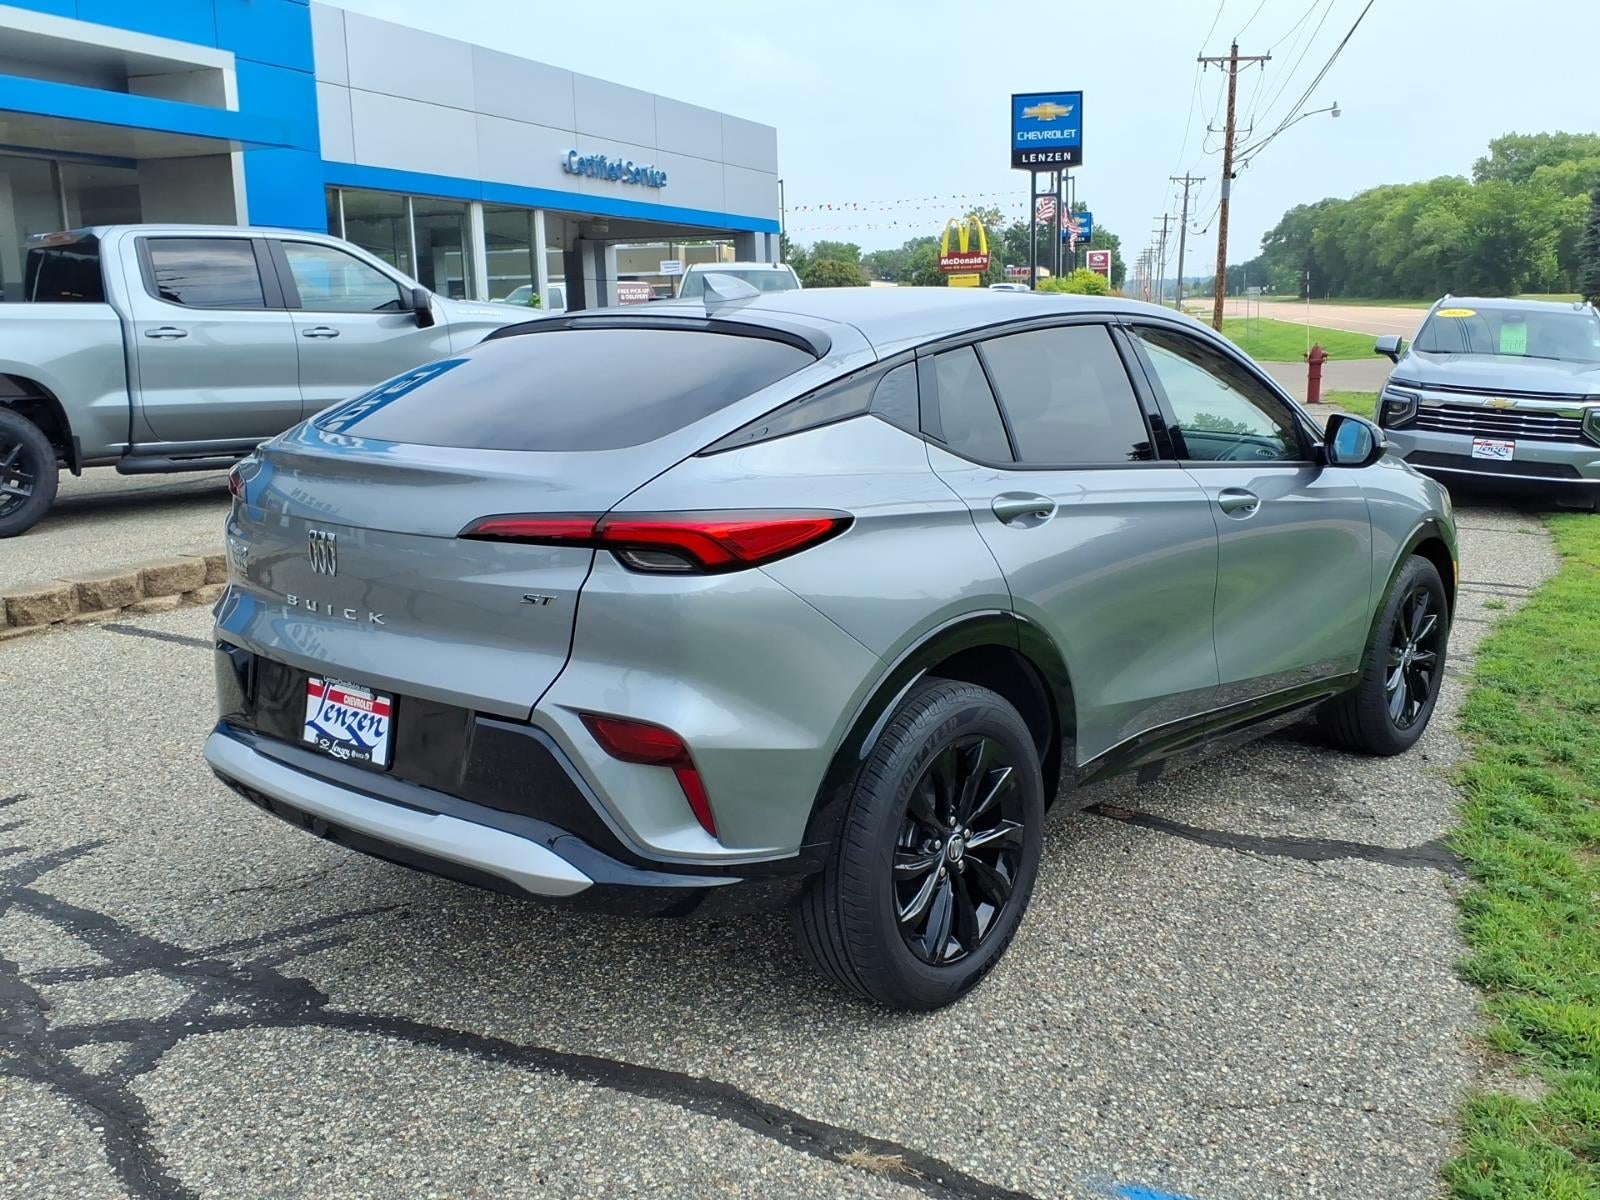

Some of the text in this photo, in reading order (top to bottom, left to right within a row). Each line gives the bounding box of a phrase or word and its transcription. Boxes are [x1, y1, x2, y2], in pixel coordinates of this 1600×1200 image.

[1017, 129, 1077, 141] CHEVROLET
[1022, 152, 1071, 163] LENZEN
[564, 150, 668, 188] Certified Service
[940, 256, 988, 267] McDonald's
[520, 593, 558, 606] ST
[286, 593, 385, 625] BUICK
[343, 694, 374, 711] CHEVROLET
[304, 681, 385, 749] Lenzen
